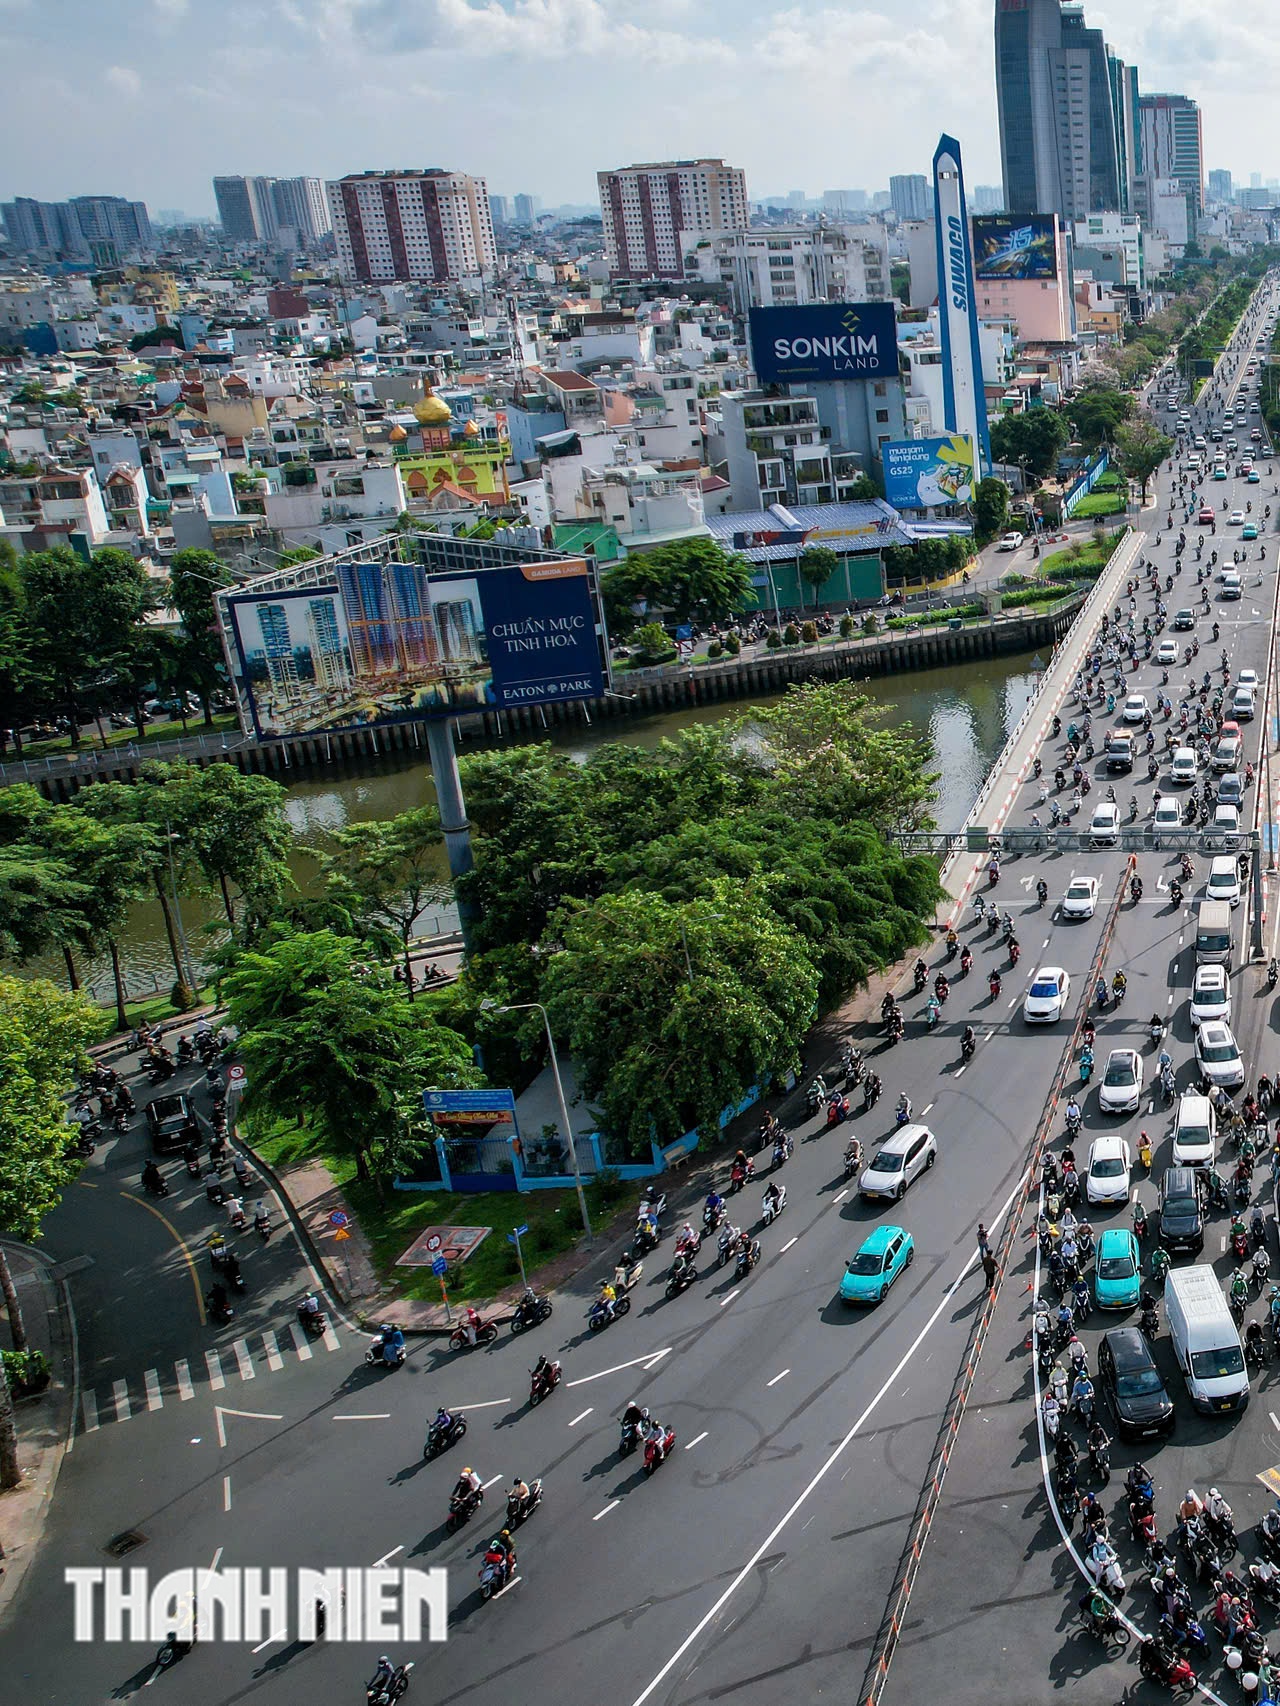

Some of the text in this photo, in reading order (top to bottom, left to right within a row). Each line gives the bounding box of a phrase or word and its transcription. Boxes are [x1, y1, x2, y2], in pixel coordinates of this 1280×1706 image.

[947, 215, 967, 312] SAWACO
[774, 334, 878, 359] SONKIM
[833, 356, 879, 370] LAND
[890, 466, 914, 476] GS25
[492, 615, 585, 637] CHUẨN MỰC
[504, 637, 540, 652] TINH
[503, 679, 592, 699] EATON PARK
